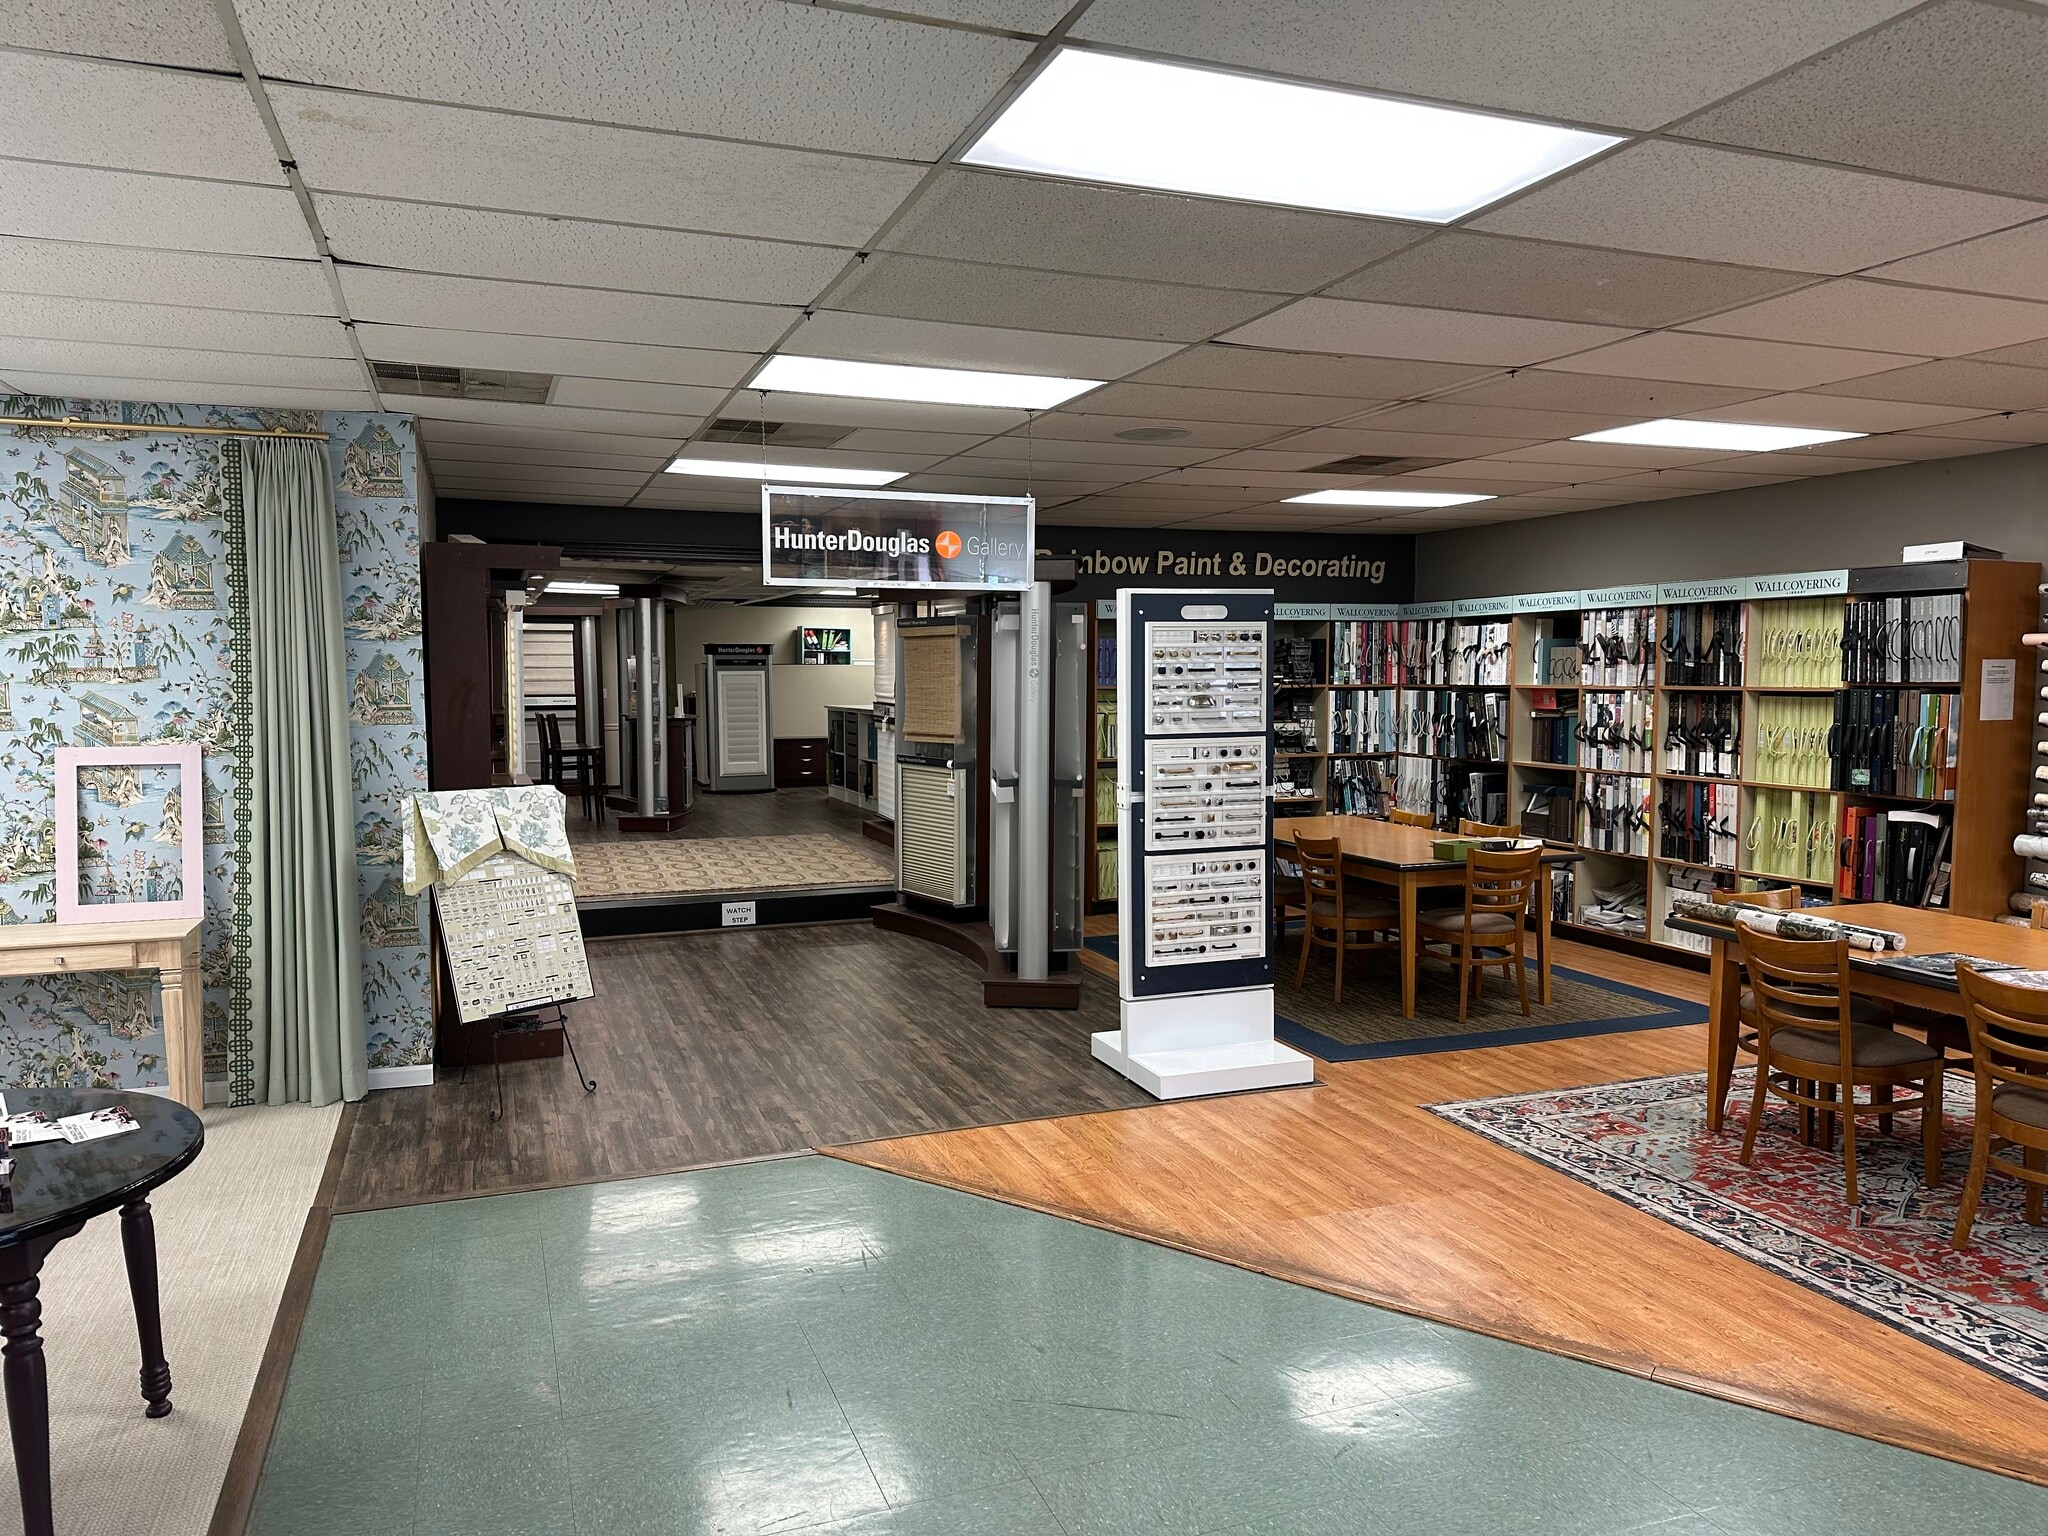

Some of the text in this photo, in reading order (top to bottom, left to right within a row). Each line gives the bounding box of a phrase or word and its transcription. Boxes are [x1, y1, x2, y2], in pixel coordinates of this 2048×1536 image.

[774, 526, 1025, 559] HunterDouglas Gallery
[1157, 550, 1222, 576] Paint
[1229, 551, 1247, 576] &
[1255, 552, 1386, 584] Decorating
[1663, 585, 1738, 599] WALLCOVERING
[1754, 578, 1841, 593] WALLCOVERING
[1518, 596, 1576, 607] WALLCOVERING
[1587, 590, 1652, 603] WALLCOVERING
[1337, 608, 1398, 617] WALLCOVERING
[1403, 605, 1449, 615] WALLCOVERING
[1457, 602, 1509, 613] WALLCOVERING
[1029, 608, 1040, 666] HunterDouglas
